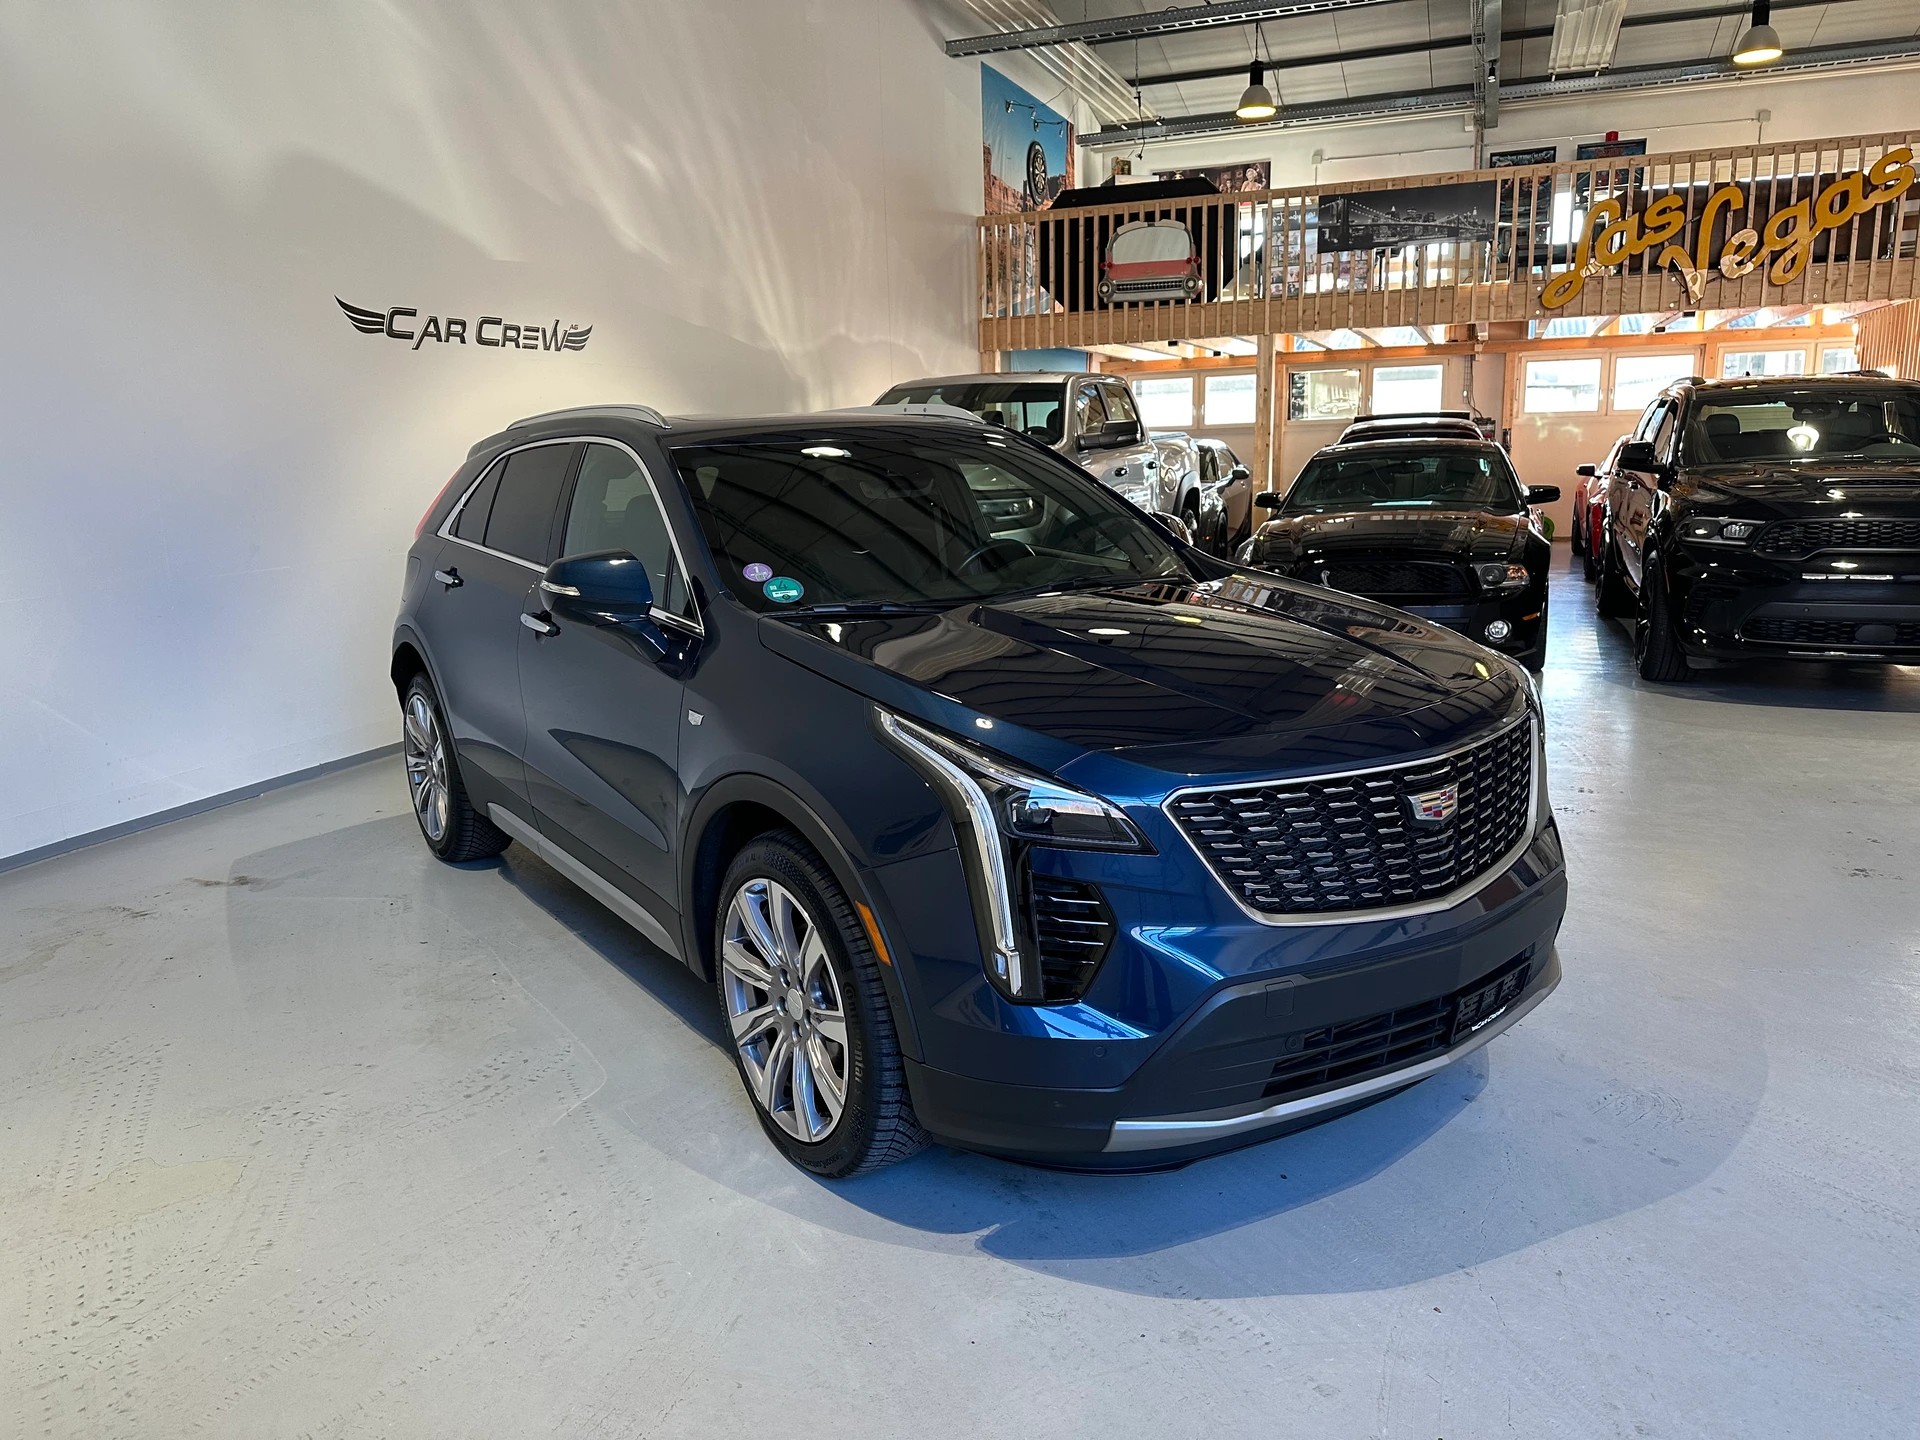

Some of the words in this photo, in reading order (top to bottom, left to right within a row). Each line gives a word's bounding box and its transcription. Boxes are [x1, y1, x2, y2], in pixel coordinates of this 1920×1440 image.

[1541, 193, 1686, 310] Las
[1657, 147, 1916, 305] Vegas
[384, 306, 467, 350] CAR
[475, 316, 568, 352] CREW
